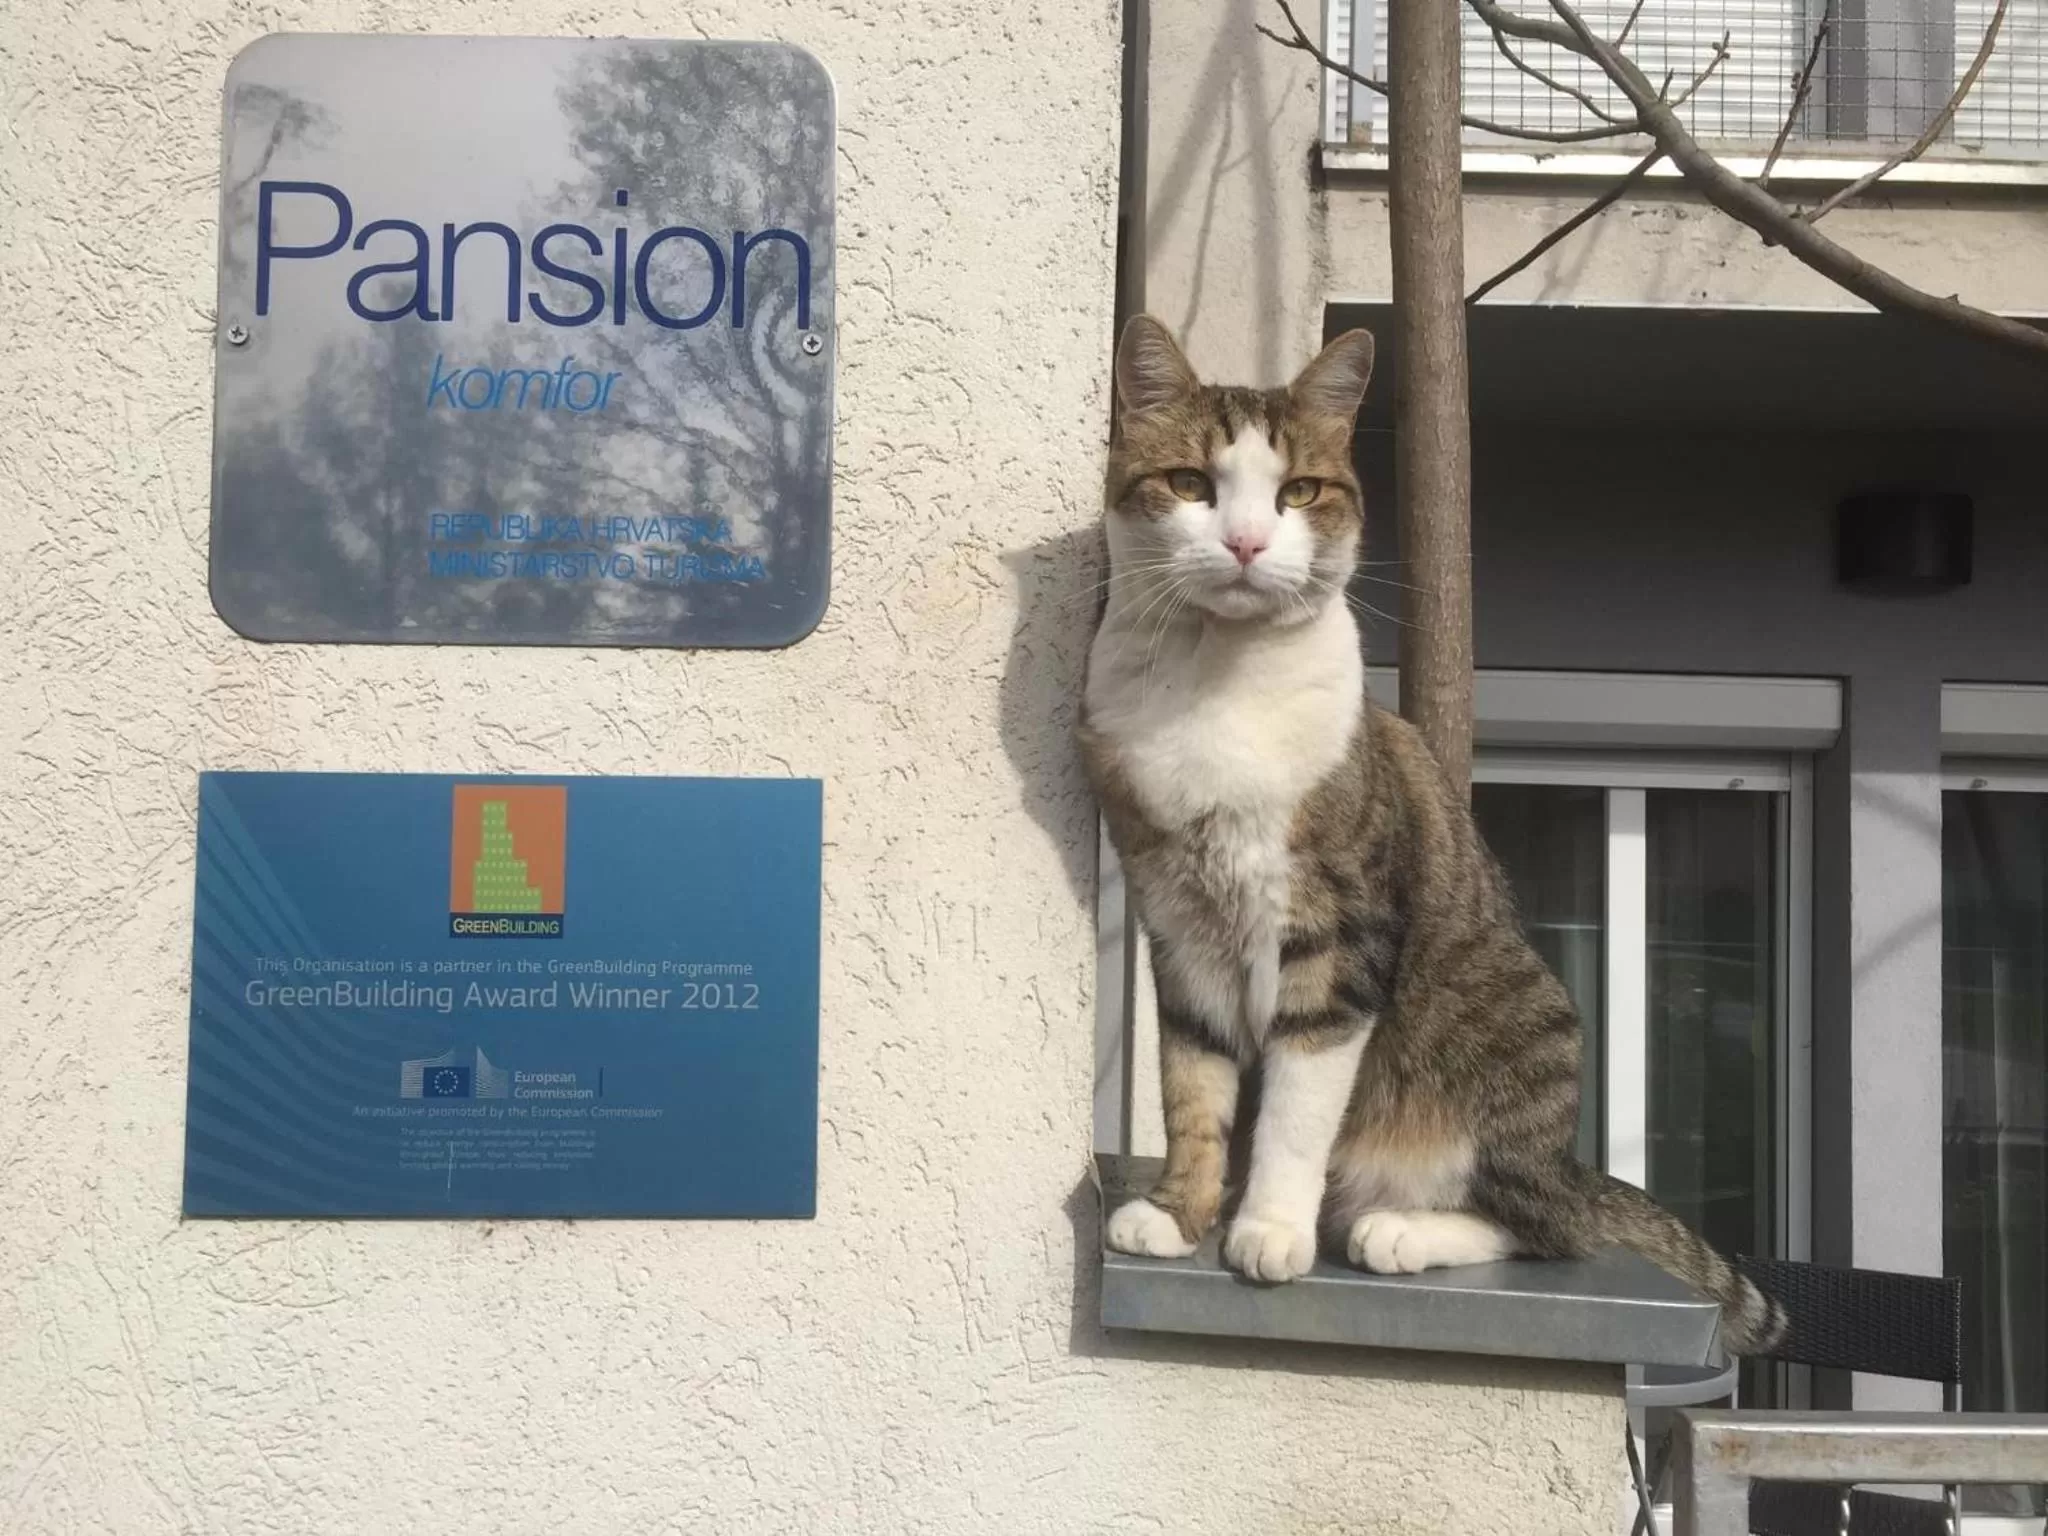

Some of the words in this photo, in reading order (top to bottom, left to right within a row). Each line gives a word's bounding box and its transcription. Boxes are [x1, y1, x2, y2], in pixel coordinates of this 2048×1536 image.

[256, 181, 811, 330] Pansion
[427, 353, 622, 411] komfor
[430, 513, 581, 540] REPUBLIKA
[594, 516, 732, 542] HRVATSKA
[429, 551, 635, 580] MINISTARSTVO
[255, 957, 287, 972] This
[293, 957, 394, 974] Organisation
[401, 959, 413, 972] is
[418, 962, 428, 973] a
[434, 961, 491, 975] partner
[497, 959, 511, 973] in
[517, 959, 542, 973] the
[548, 959, 656, 976] GreenBuilding
[662, 960, 753, 978] Programme
[245, 980, 452, 1013] GreenBuilding
[464, 981, 557, 1008] Award
[569, 982, 671, 1009] Winner
[681, 983, 759, 1009] 2012
[514, 1071, 576, 1085] European
[514, 1087, 593, 1099] Commission
[428, 1105, 486, 1120] promoted
[490, 1105, 505, 1120] by
[508, 1105, 527, 1118] the
[531, 1106, 586, 1119] European
[591, 1106, 663, 1118] Commission
